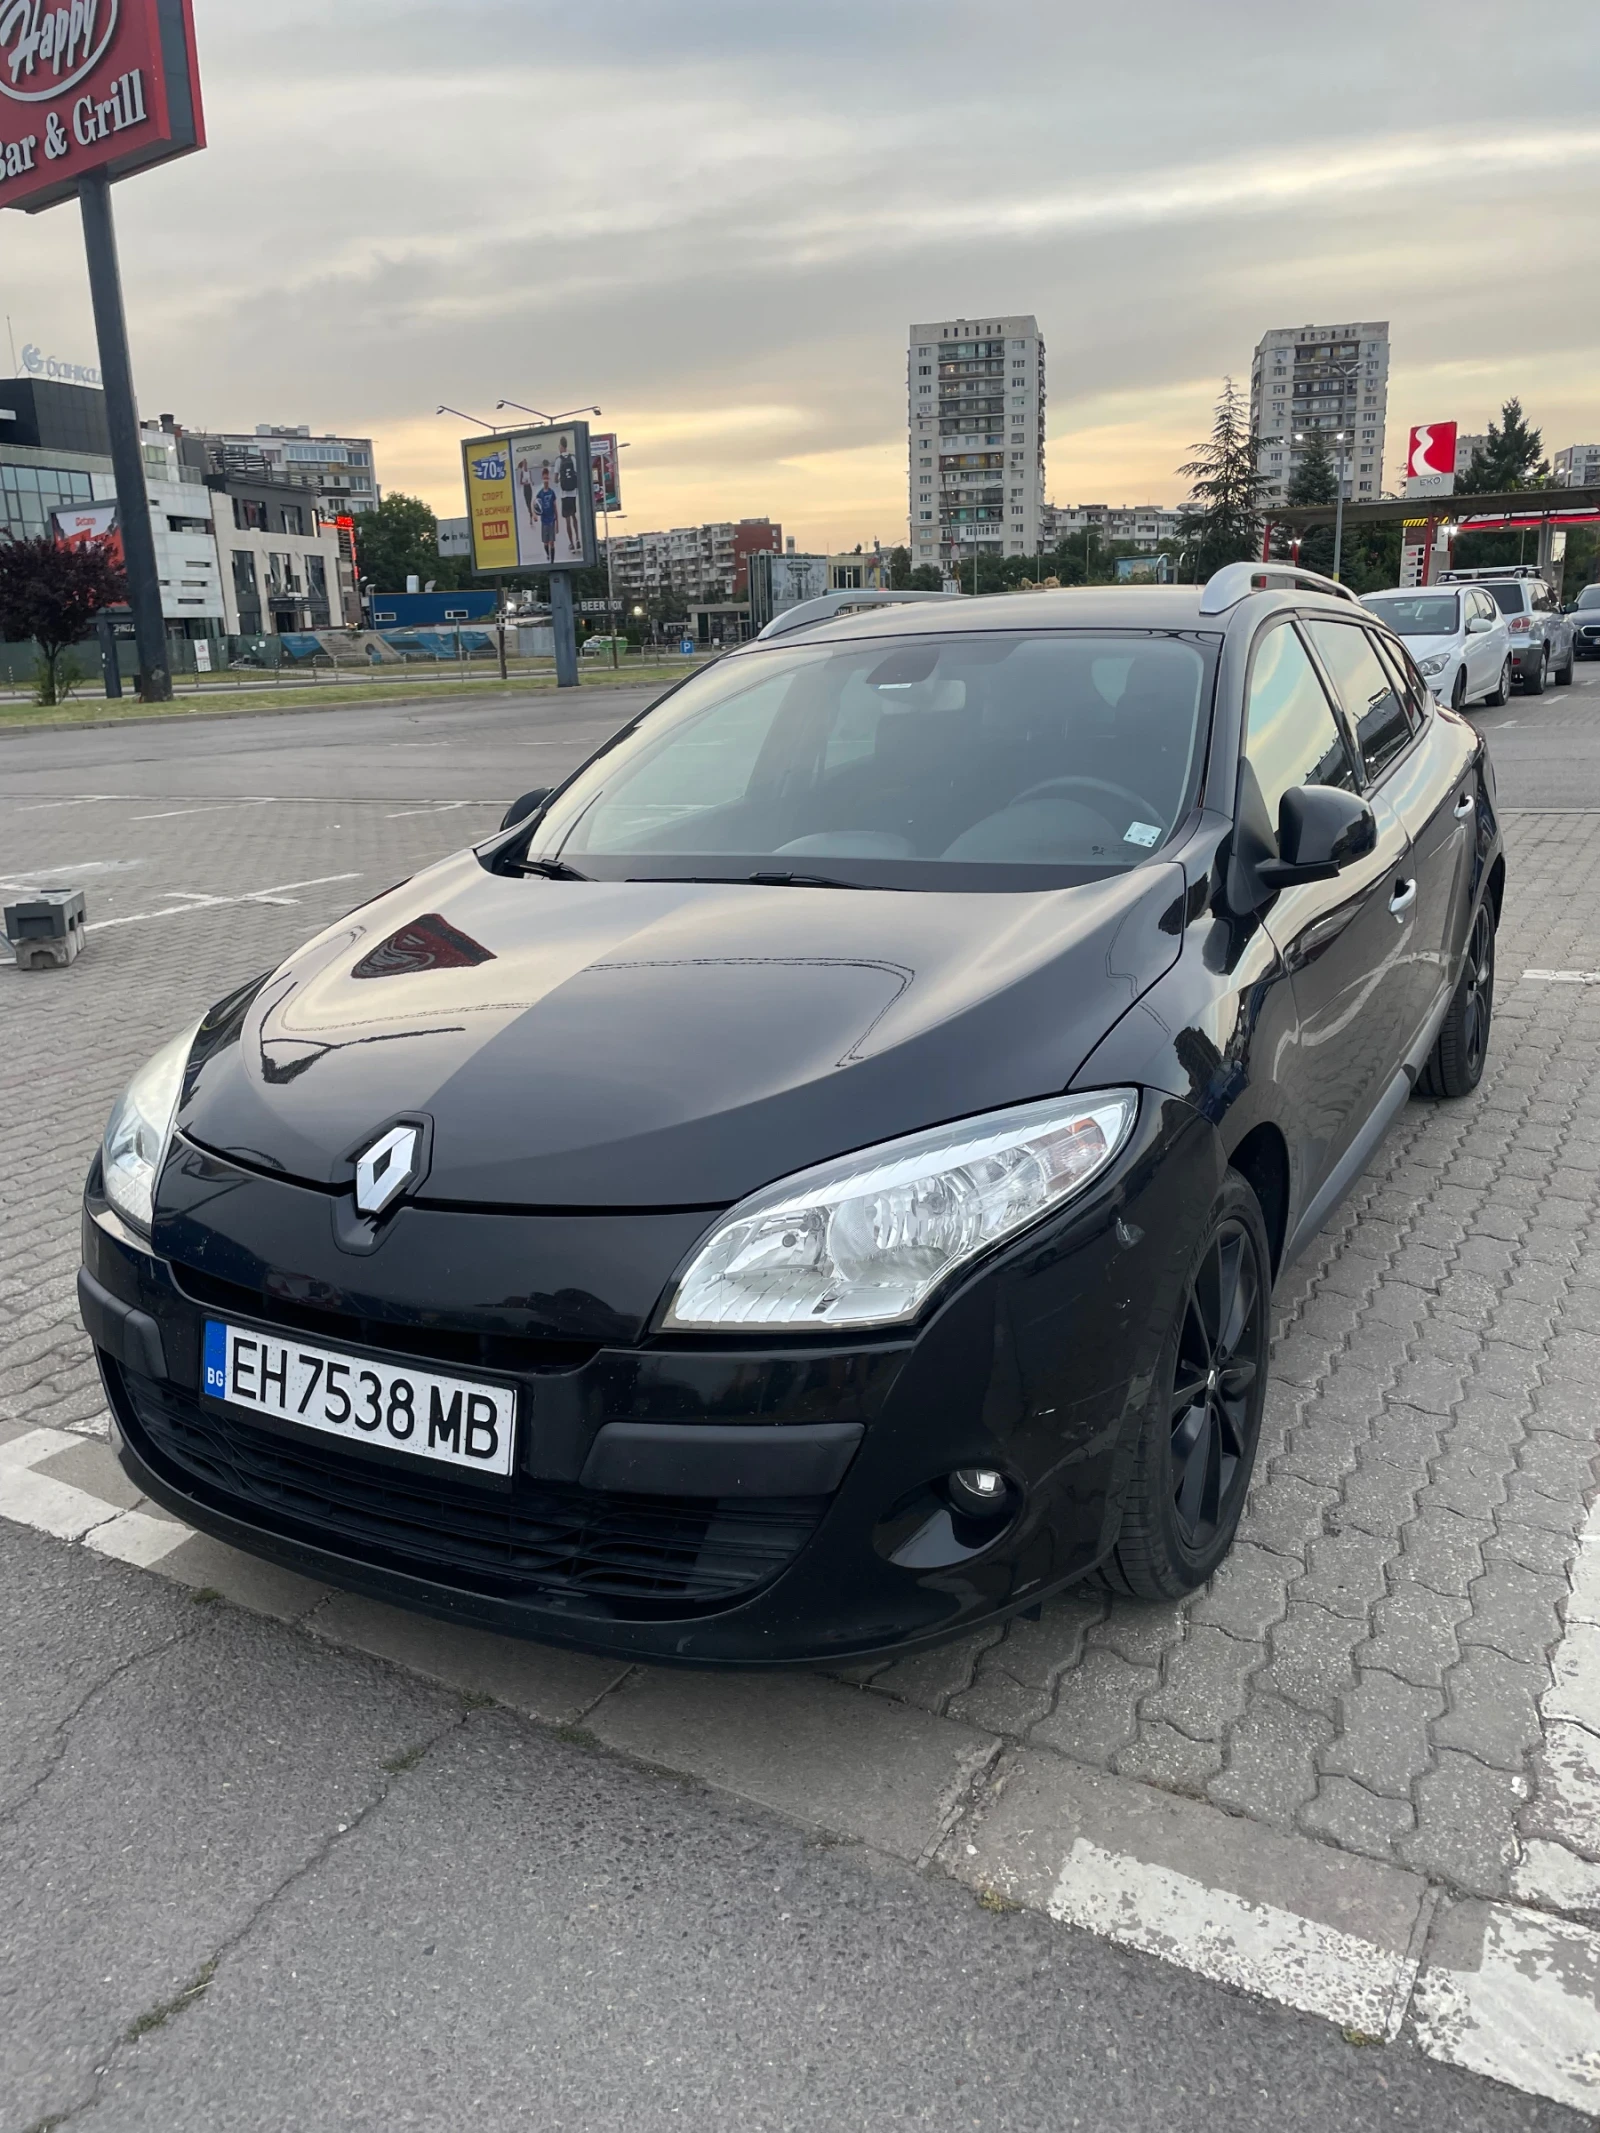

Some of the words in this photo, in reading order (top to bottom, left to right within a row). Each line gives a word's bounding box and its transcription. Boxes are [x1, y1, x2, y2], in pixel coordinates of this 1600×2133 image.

[0, 0, 98, 84] Happy
[44, 112, 68, 160] &
[73, 68, 147, 146] Grill
[1420, 476, 1441, 487] EKO
[482, 490, 504, 502] СПОРТ
[484, 523, 508, 537] BILLA
[581, 600, 606, 611] BEER
[683, 642, 691, 652] P
[207, 1366, 224, 1388] BG
[232, 1336, 288, 1408] EH
[297, 1353, 415, 1440] 7538
[428, 1385, 499, 1459] MB
